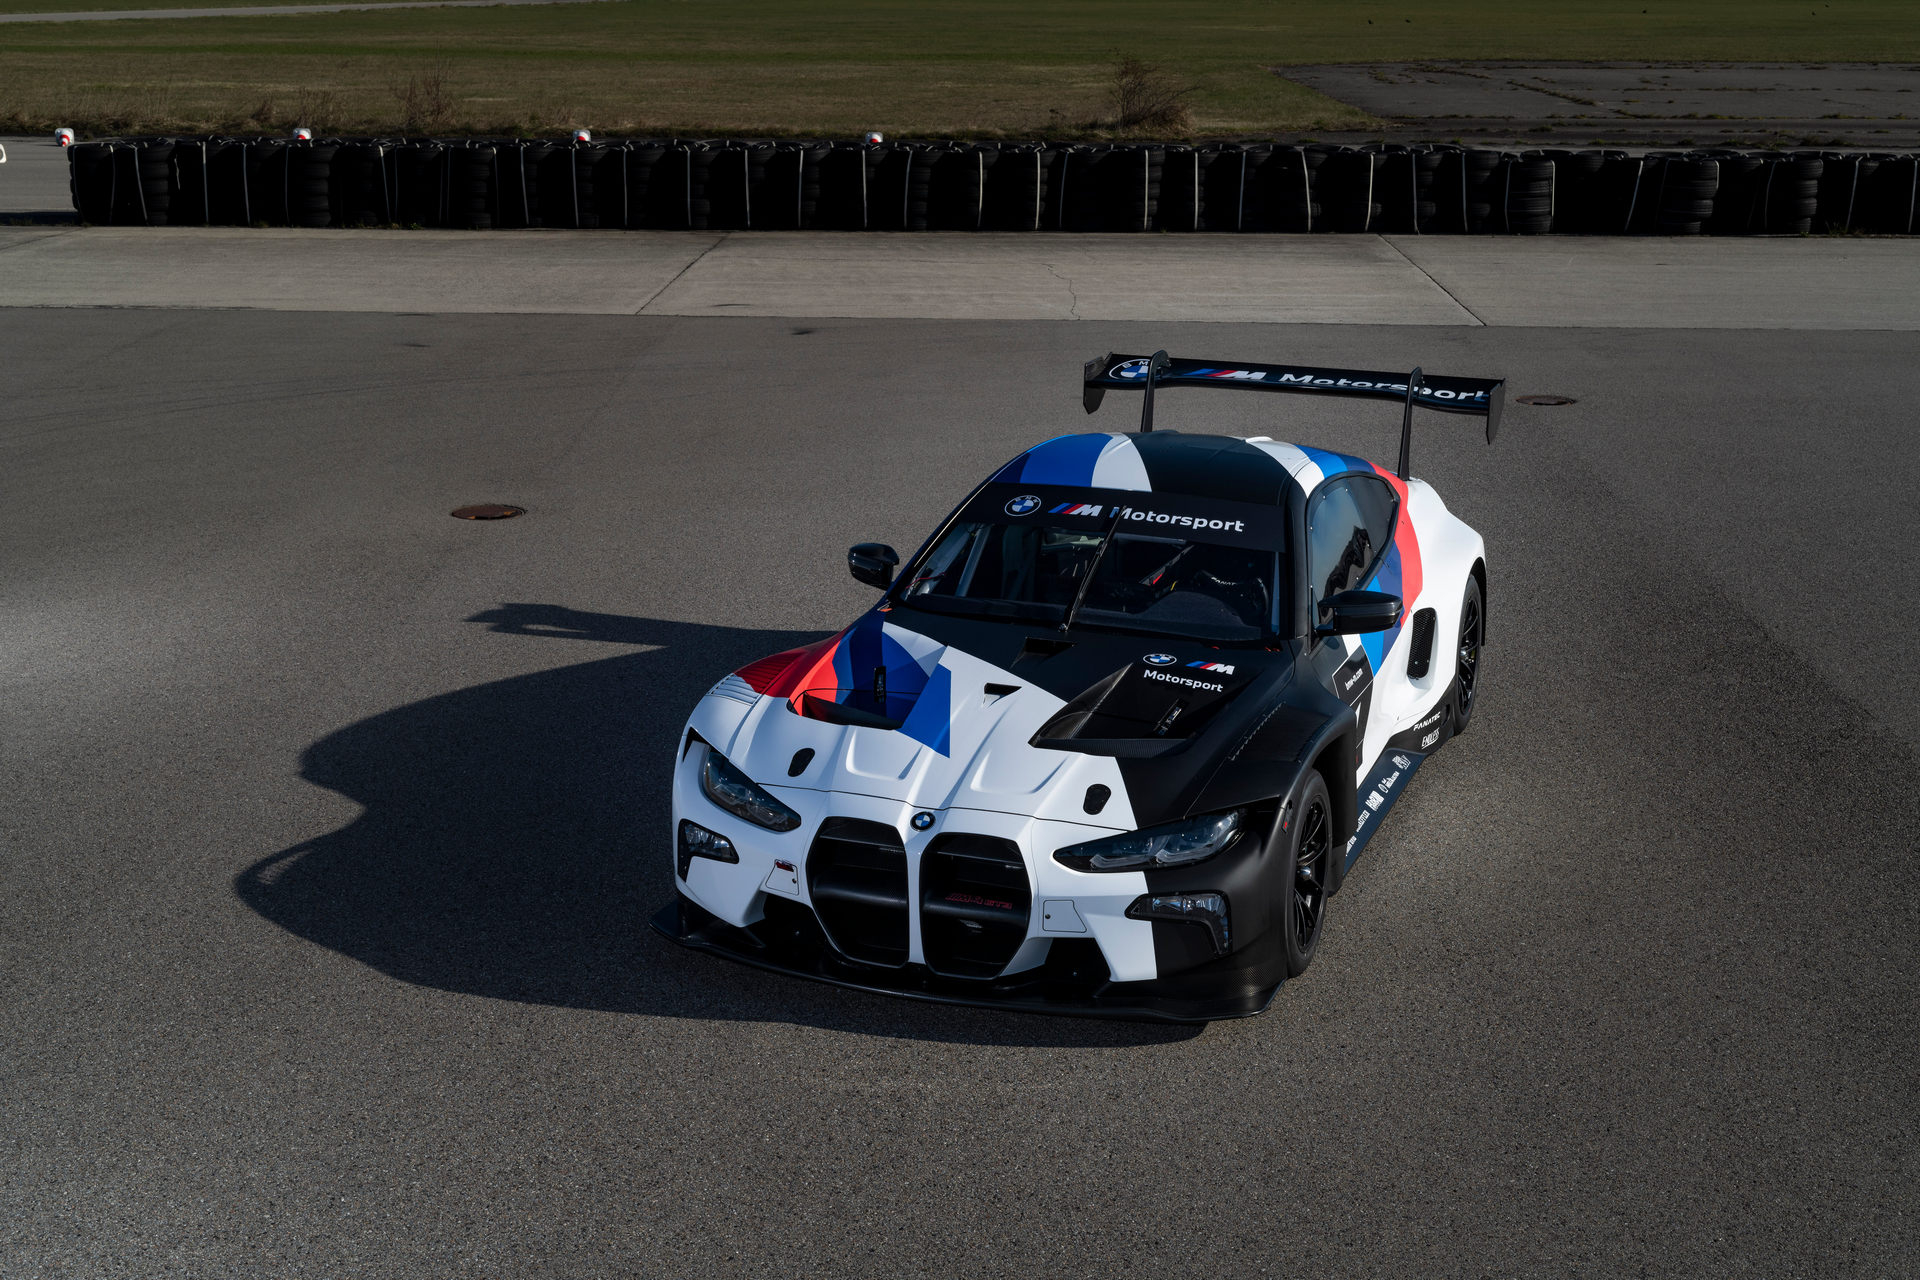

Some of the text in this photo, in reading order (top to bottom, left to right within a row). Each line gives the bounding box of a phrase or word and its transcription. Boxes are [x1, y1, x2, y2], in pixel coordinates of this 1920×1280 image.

[1277, 373, 1489, 402] Motorsport
[1108, 506, 1245, 533] Motorsport
[1143, 669, 1224, 693] Motorsport
[1413, 711, 1441, 731] FANATEC
